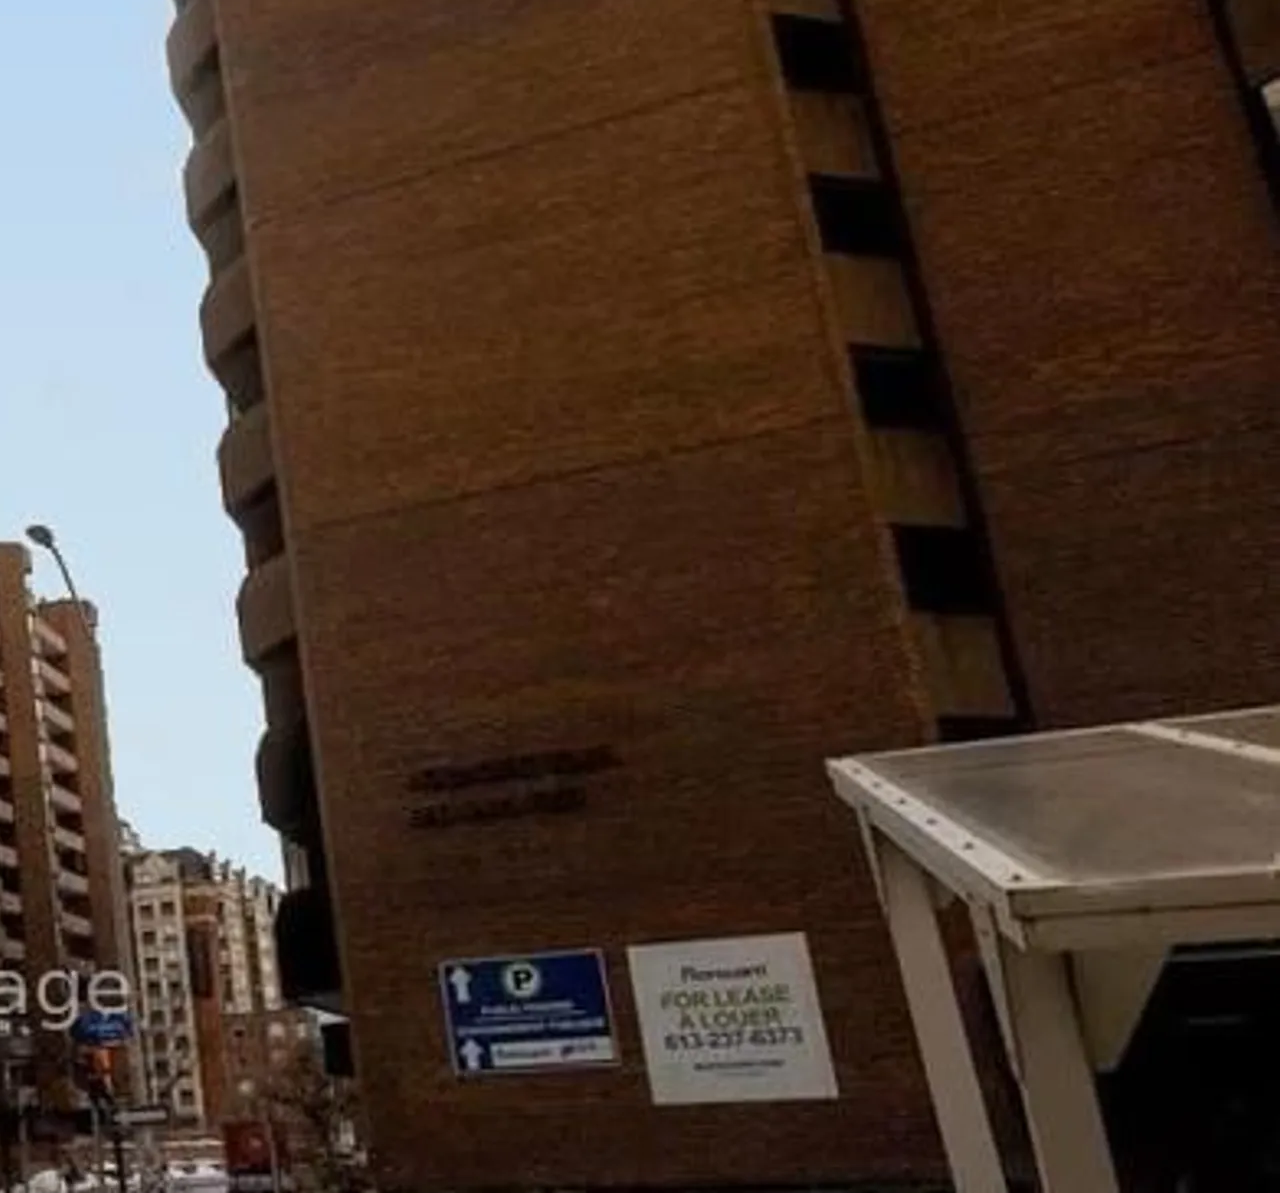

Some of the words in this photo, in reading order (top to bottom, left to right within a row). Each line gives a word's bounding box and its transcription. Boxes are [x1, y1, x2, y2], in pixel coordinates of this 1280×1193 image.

[512, 970, 533, 990] P
[661, 990, 710, 1011] FOR
[714, 983, 790, 1007] LEASE
[700, 1006, 783, 1029] LOUER
